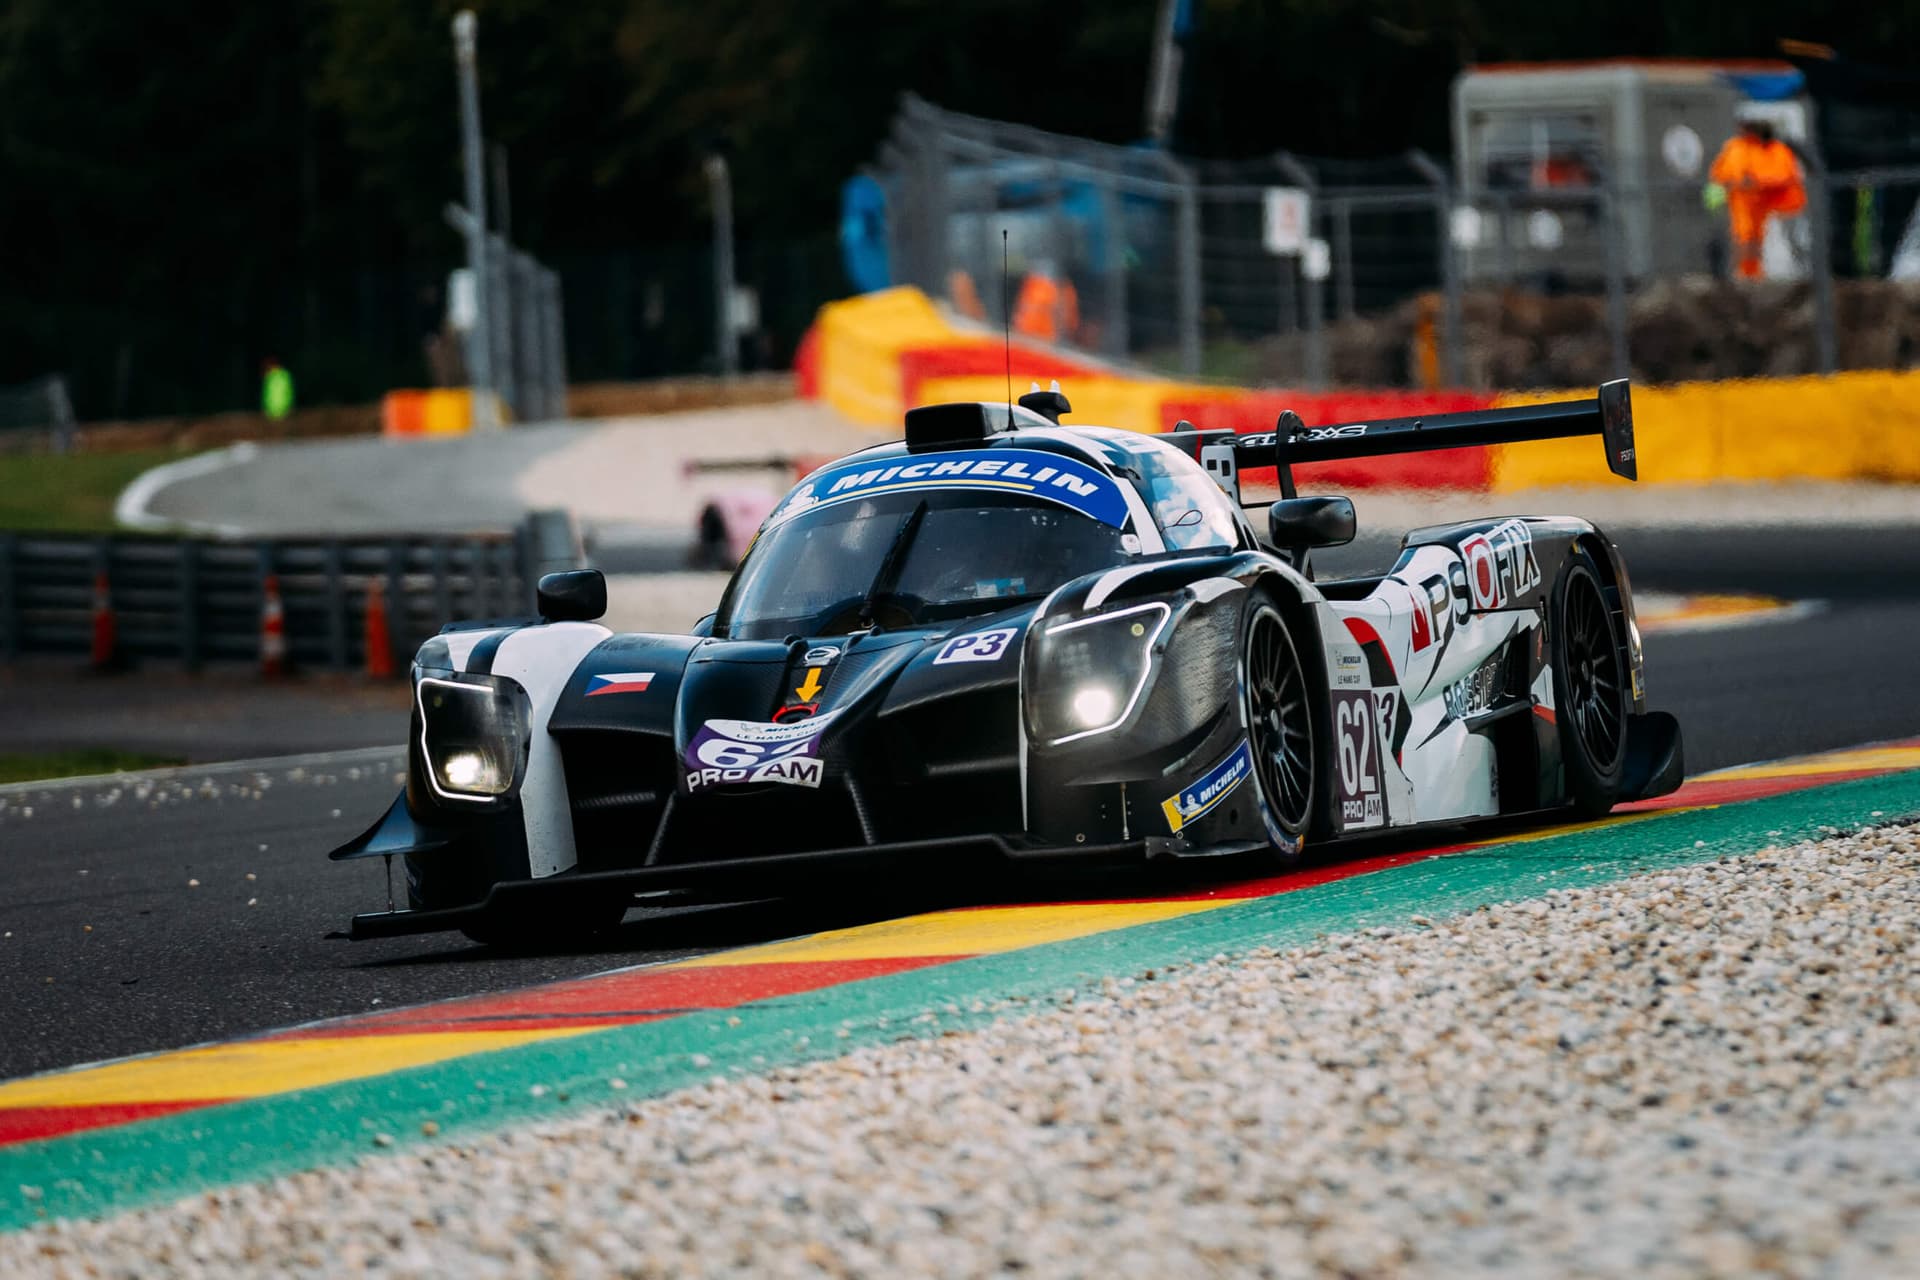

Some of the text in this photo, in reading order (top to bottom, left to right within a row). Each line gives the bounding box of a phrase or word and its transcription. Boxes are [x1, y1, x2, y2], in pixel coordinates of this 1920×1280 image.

[826, 460, 1099, 497] MICHELIN
[940, 633, 1007, 659] P3
[1337, 698, 1376, 796] 62
[686, 761, 818, 793] PRO AM
[1200, 756, 1245, 803] MICHELIN
[1344, 799, 1381, 819] PRO AM
